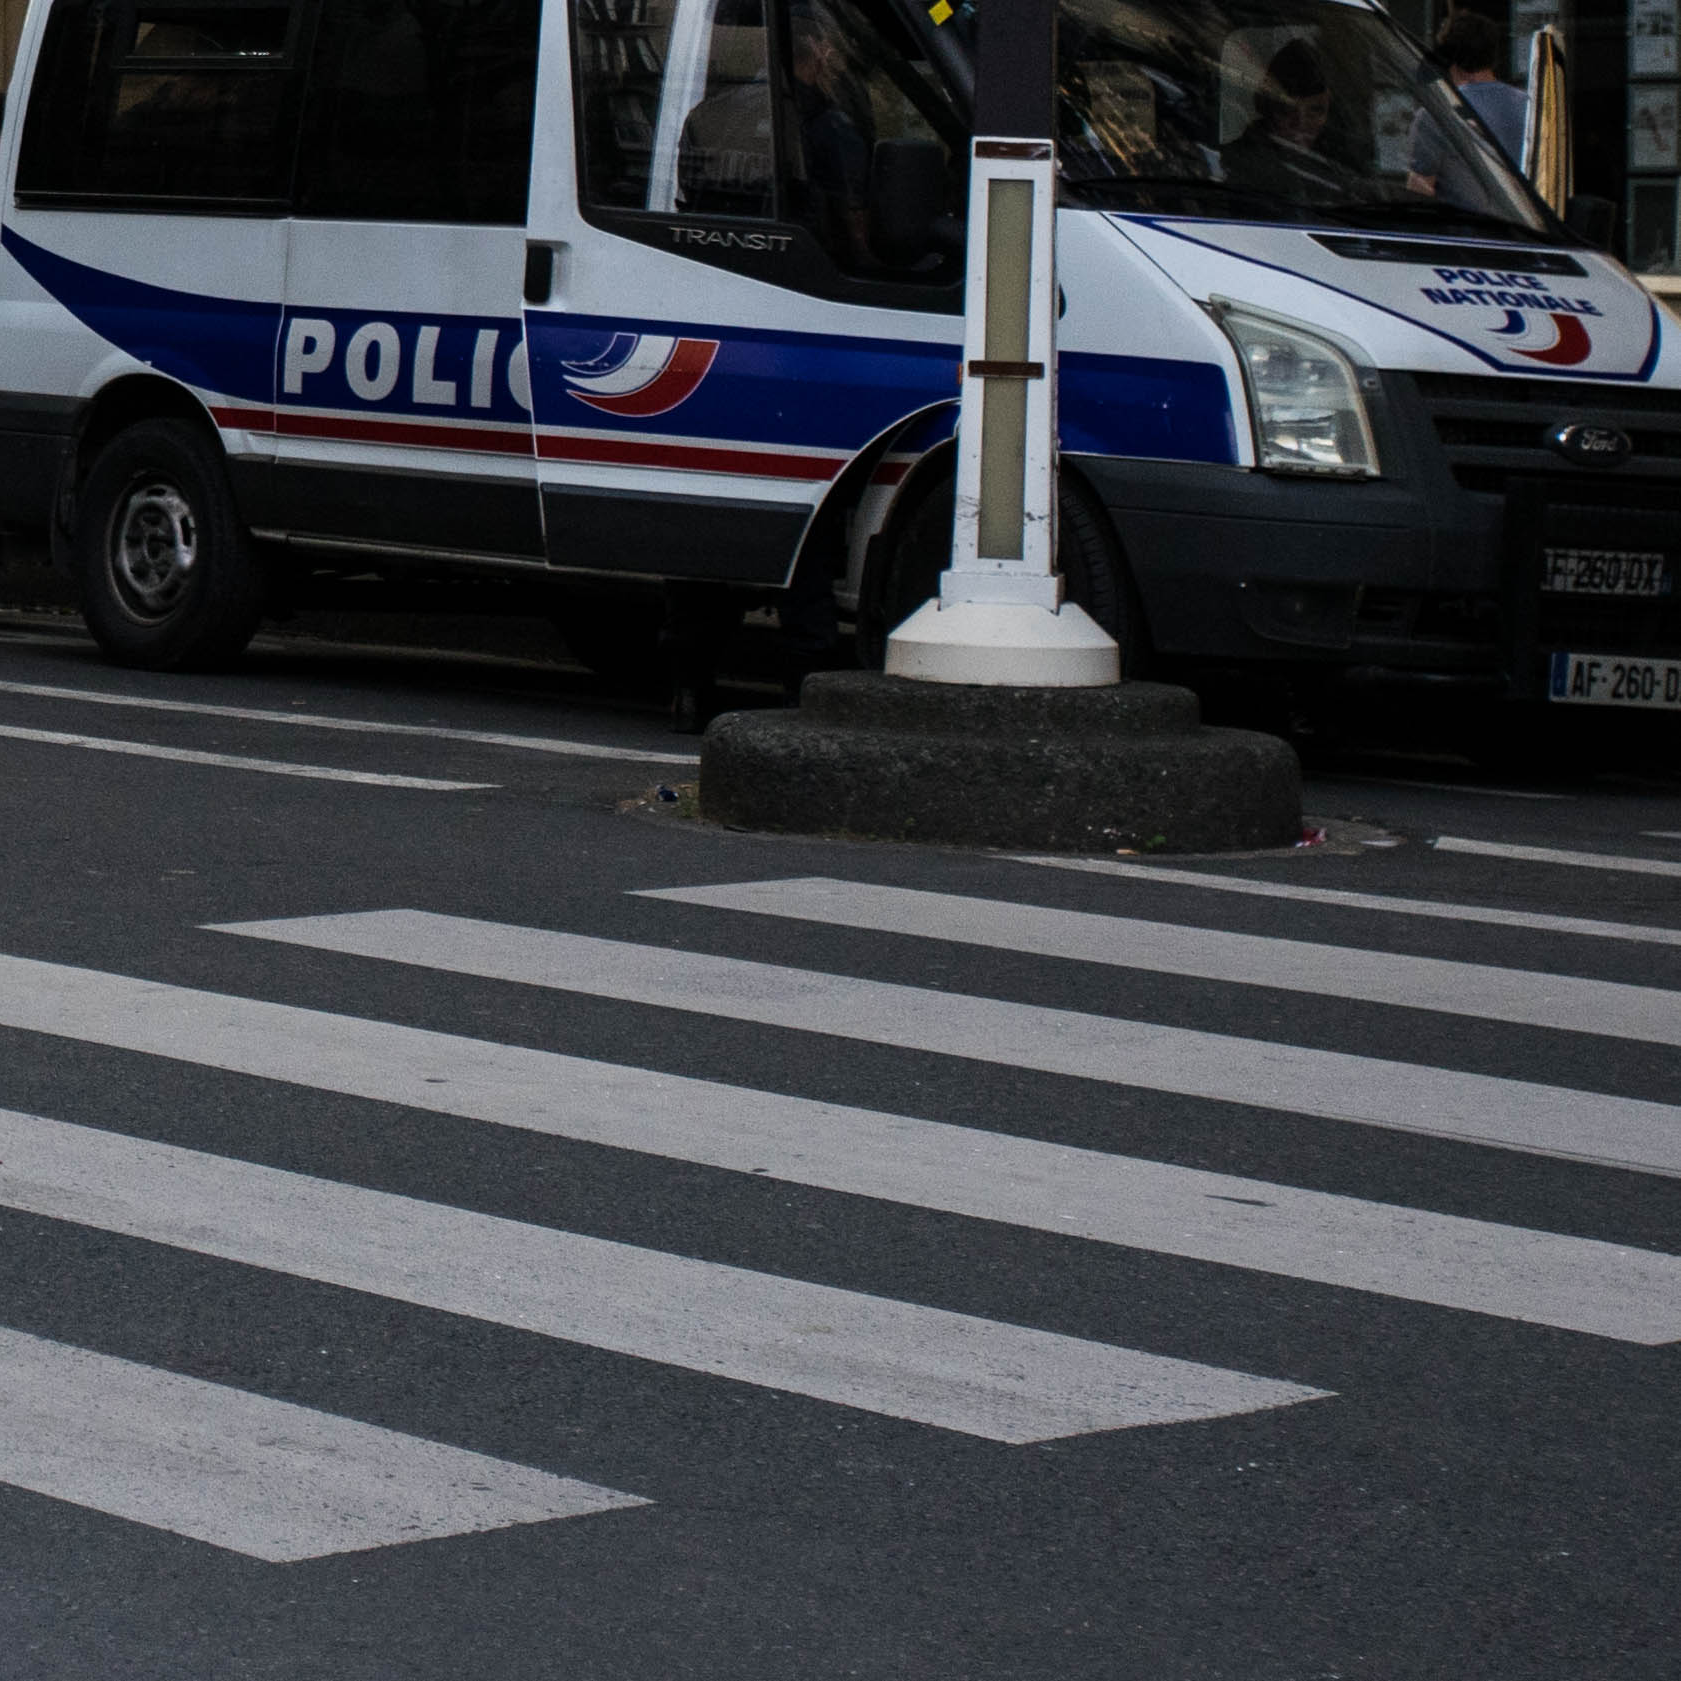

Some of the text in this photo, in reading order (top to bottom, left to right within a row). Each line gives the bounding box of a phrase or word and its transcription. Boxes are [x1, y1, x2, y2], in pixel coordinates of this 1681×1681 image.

[667, 226, 793, 252] TRANSIT
[1432, 268, 1550, 291] POLICE
[1419, 287, 1604, 317] NATIONALE
